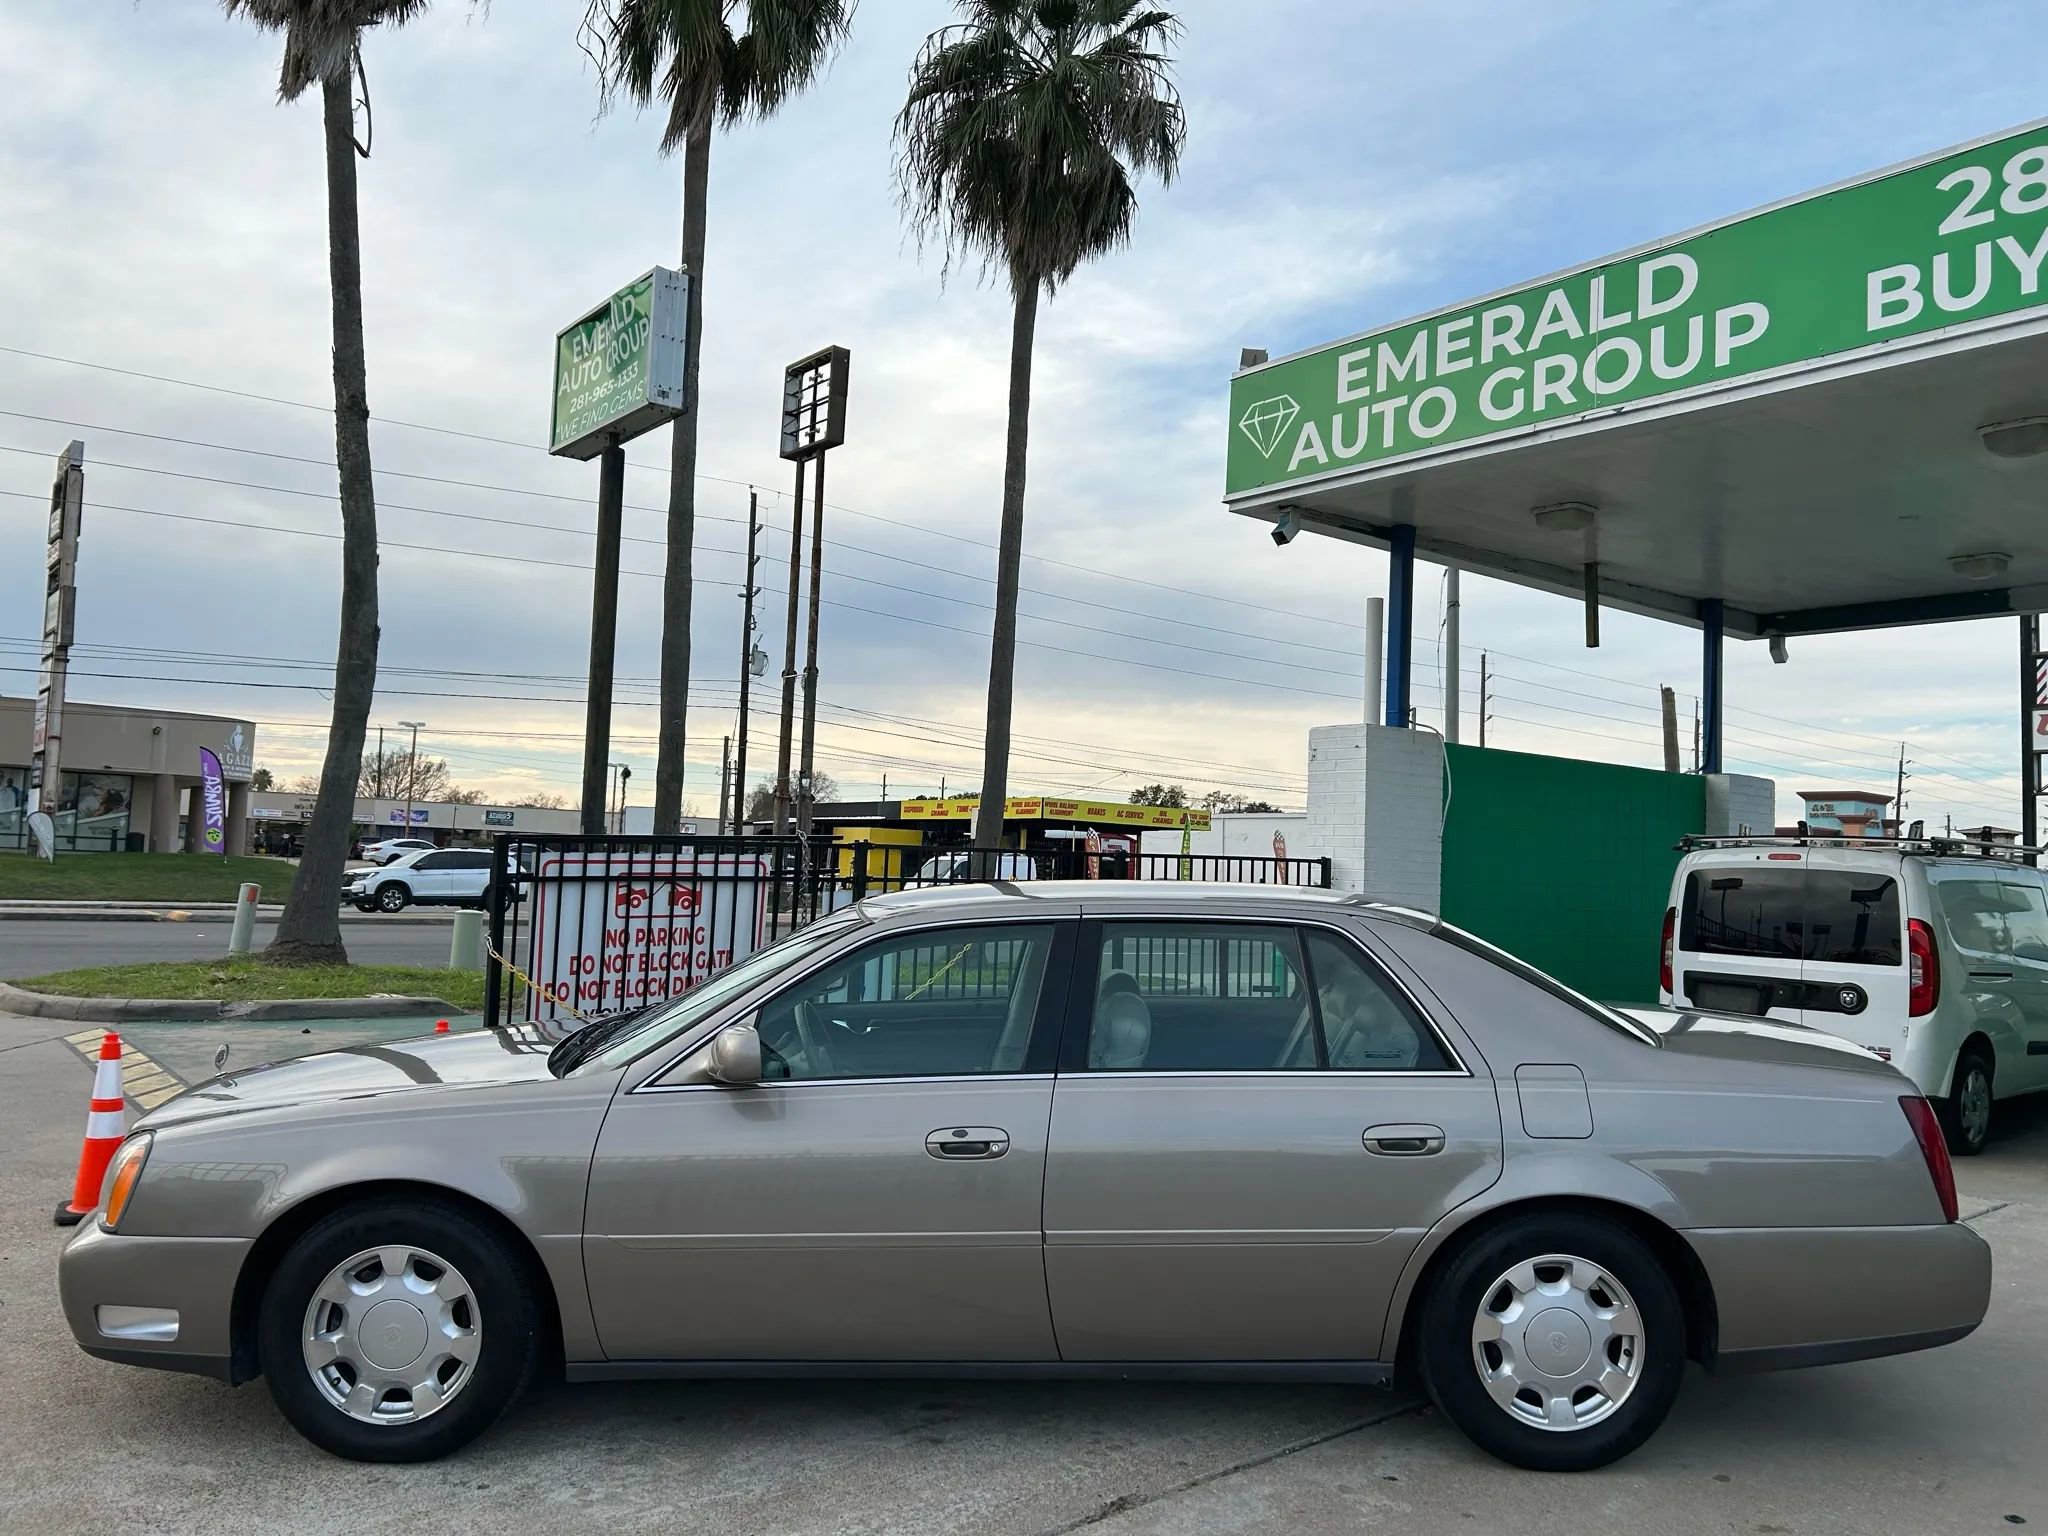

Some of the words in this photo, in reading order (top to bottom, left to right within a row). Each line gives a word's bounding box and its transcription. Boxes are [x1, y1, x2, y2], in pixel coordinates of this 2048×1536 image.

[1936, 145, 2048, 236] 28
[1867, 226, 2048, 332] BUY
[1337, 253, 1699, 404] EMERALD
[558, 355, 602, 396] AUTO
[606, 317, 650, 373] GROUP
[569, 360, 639, 413] 281-965-1333
[1286, 386, 1457, 472] AUTO
[1478, 301, 1770, 422] GROUP
[580, 401, 608, 429] FIND
[1059, 802, 1079, 810] BALANCE
[1087, 807, 1106, 816] BRAKES
[1124, 810, 1144, 819] SERVICE
[1152, 817, 1174, 825] CHANGE
[606, 928, 630, 948] NO
[635, 926, 705, 947] PARKING
[570, 954, 595, 975] DO
[602, 953, 634, 973] NOT
[639, 951, 690, 973] BLOCK
[696, 949, 734, 970] GATE
[544, 982, 570, 1003] DO
[577, 979, 610, 1001] NOT
[614, 976, 669, 999] BLOCK
